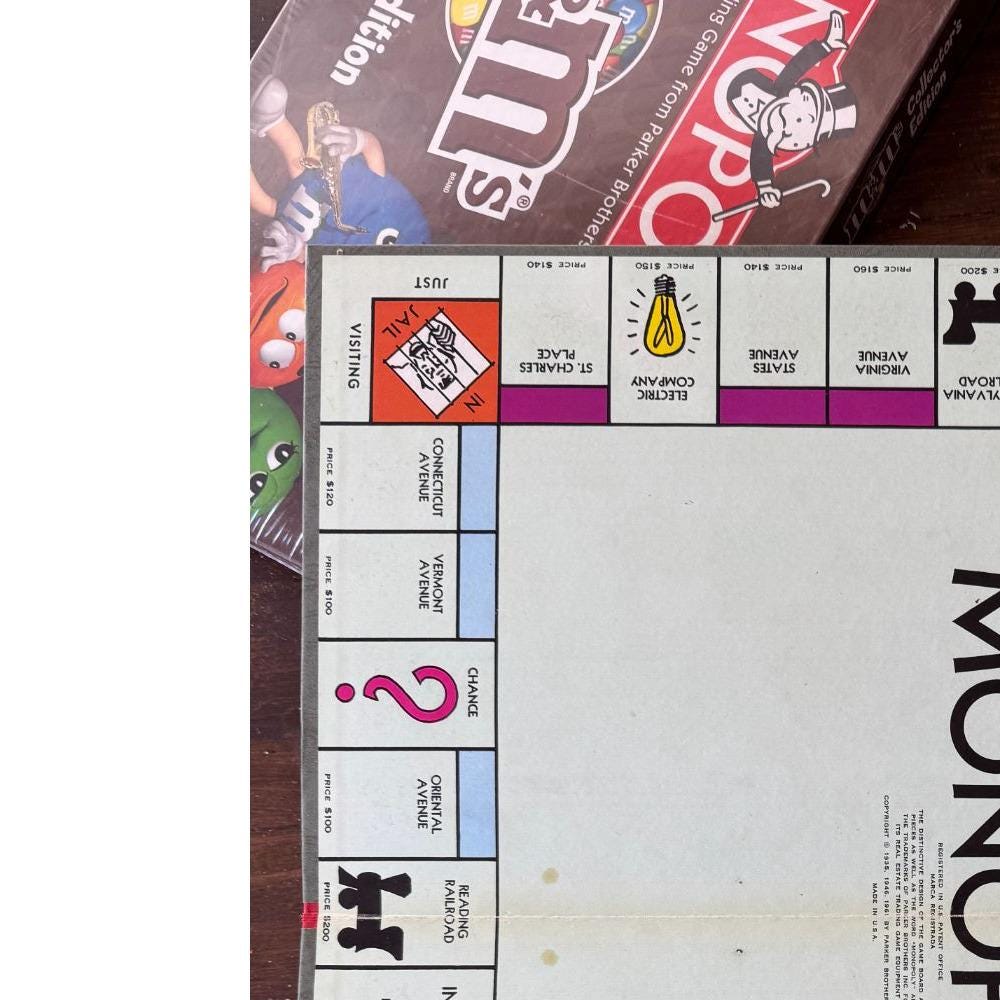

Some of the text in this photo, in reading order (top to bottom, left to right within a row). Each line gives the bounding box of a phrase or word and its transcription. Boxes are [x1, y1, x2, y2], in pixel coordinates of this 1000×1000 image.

[682, 28, 718, 78] Game
[907, 19, 963, 116] Collector's
[654, 78, 690, 127] from
[909, 70, 947, 138] Edition
[626, 120, 664, 178] Parker
[579, 178, 629, 245] Brothers
[415, 277, 448, 289] JUST
[559, 261, 586, 269] PRICE
[381, 304, 419, 338] JAIL
[348, 323, 361, 388] VISITING
[520, 362, 592, 373] ST. CHARLES
[537, 349, 575, 360] PLACE
[749, 349, 799, 360] AVENUE
[754, 363, 795, 373] STATES
[856, 364, 910, 375] VIRGINIA
[858, 351, 908, 361] AVENUE
[464, 393, 485, 413] IN
[631, 376, 695, 387] COMPANY
[638, 390, 687, 400] ELECTRIC
[326, 448, 334, 506] PRICE $120
[419, 452, 429, 502] AVENUE
[433, 438, 443, 517] CONNECTICUT
[419, 560, 429, 609] AVENUE
[433, 554, 443, 613] VERMONT
[468, 667, 478, 717] CHANCE
[417, 779, 428, 828] AVENUE
[431, 775, 442, 834] ORIENTAL
[444, 880, 455, 943] RAILROAD
[458, 885, 469, 938] READING
